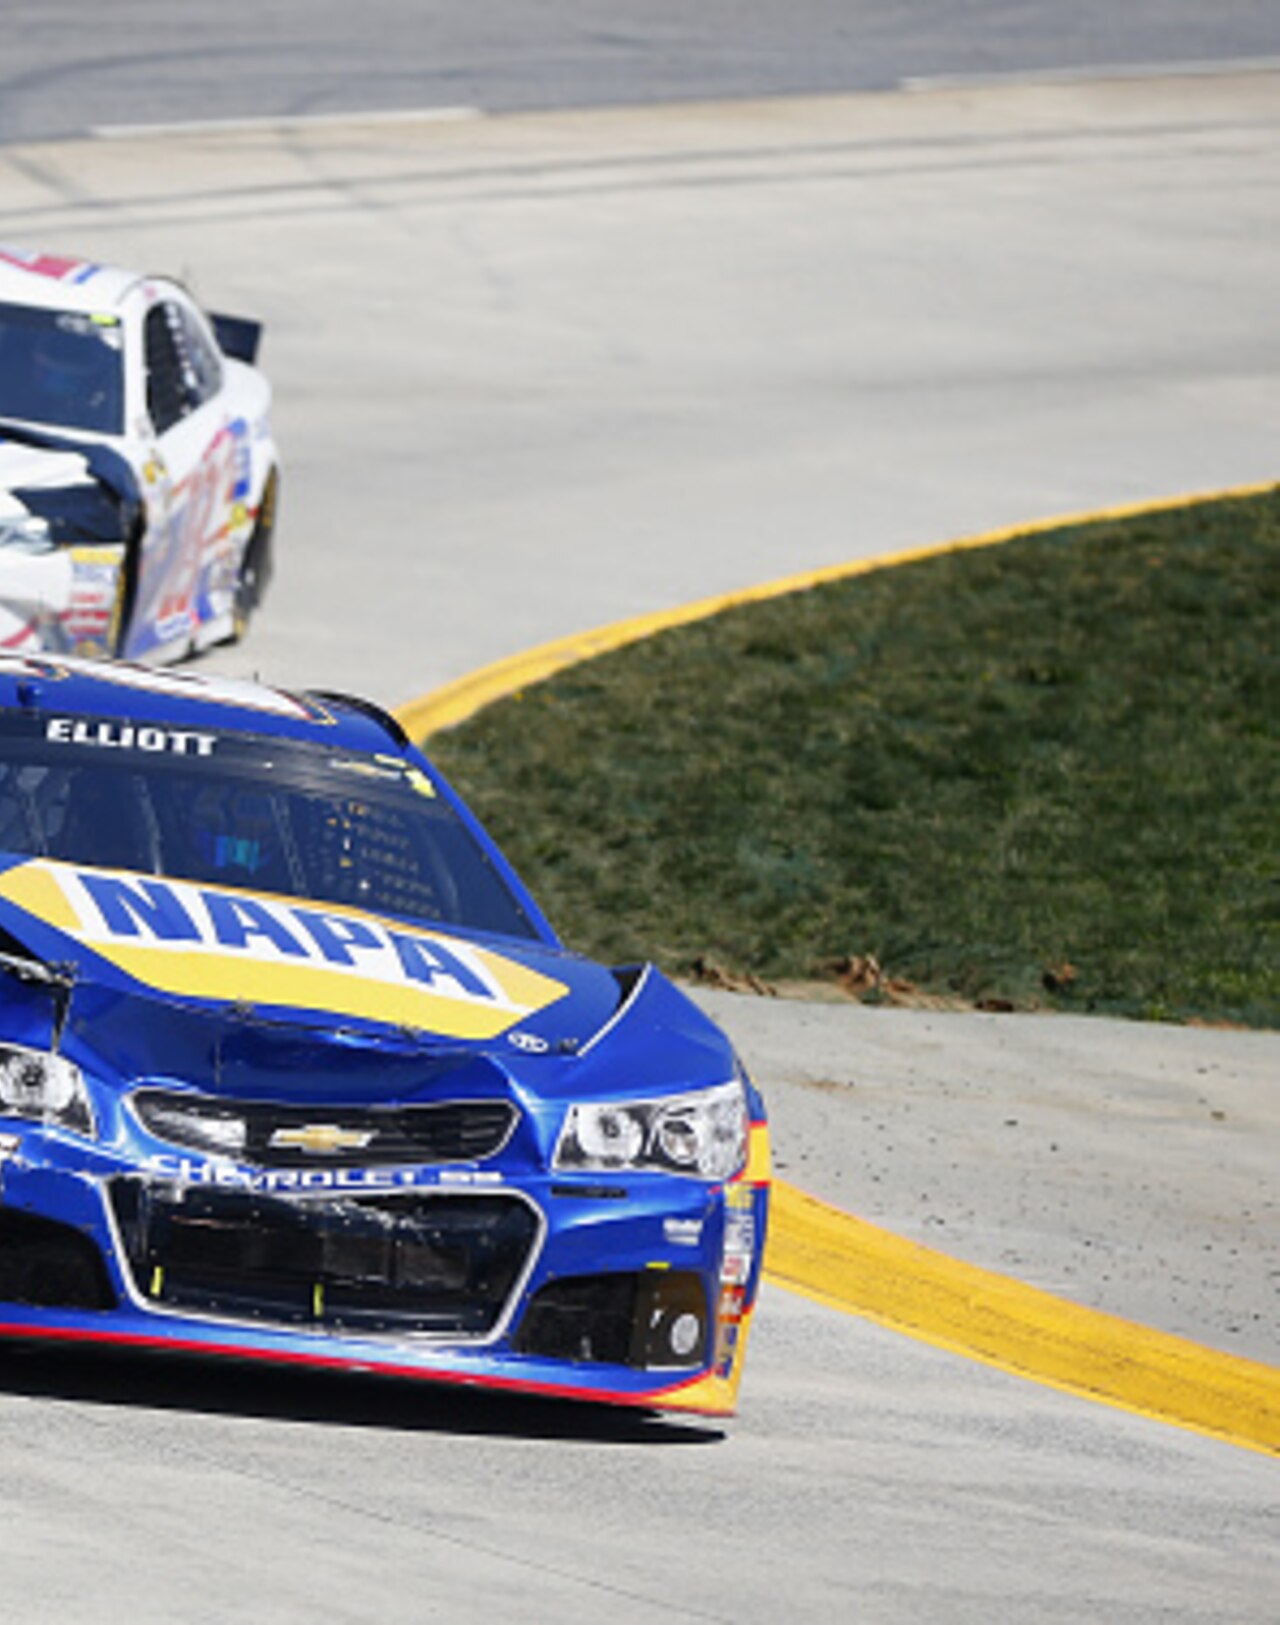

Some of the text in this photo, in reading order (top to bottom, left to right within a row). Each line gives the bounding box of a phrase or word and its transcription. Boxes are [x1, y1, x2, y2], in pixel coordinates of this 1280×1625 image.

[46, 718, 217, 756] ELLIOTT
[77, 873, 498, 1001] NAPA
[148, 1154, 425, 1192] CHEVROLET
